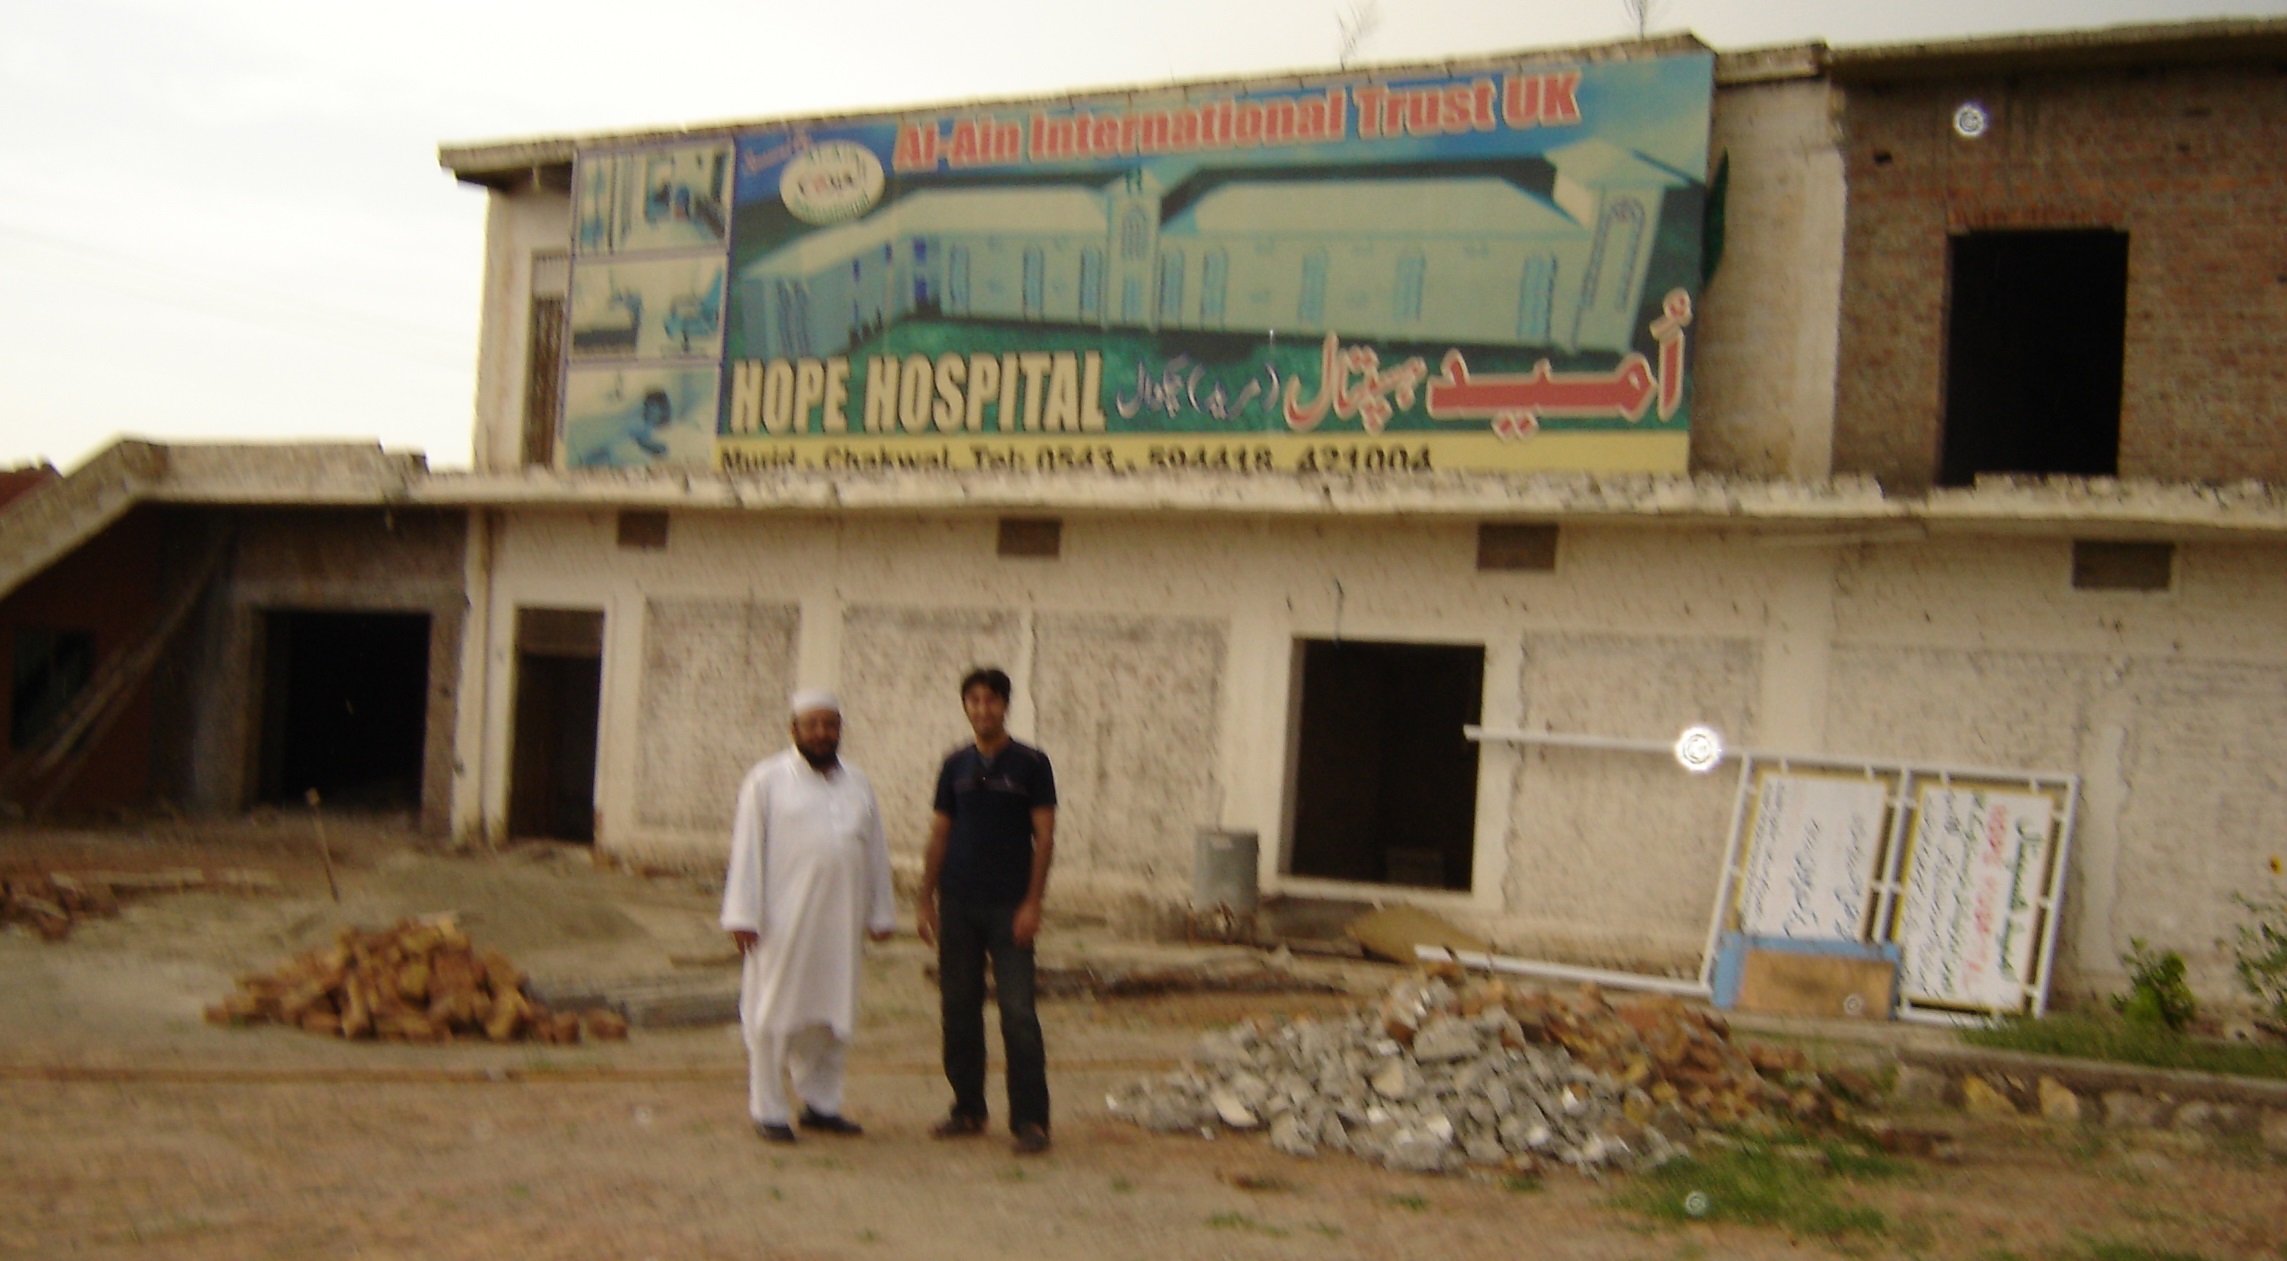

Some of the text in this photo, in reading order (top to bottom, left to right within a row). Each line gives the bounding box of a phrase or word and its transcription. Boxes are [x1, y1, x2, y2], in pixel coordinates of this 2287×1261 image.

[893, 67, 1582, 173] Al-Ain International Trust UK
[730, 349, 1106, 435] HOPE HOSPITAL
